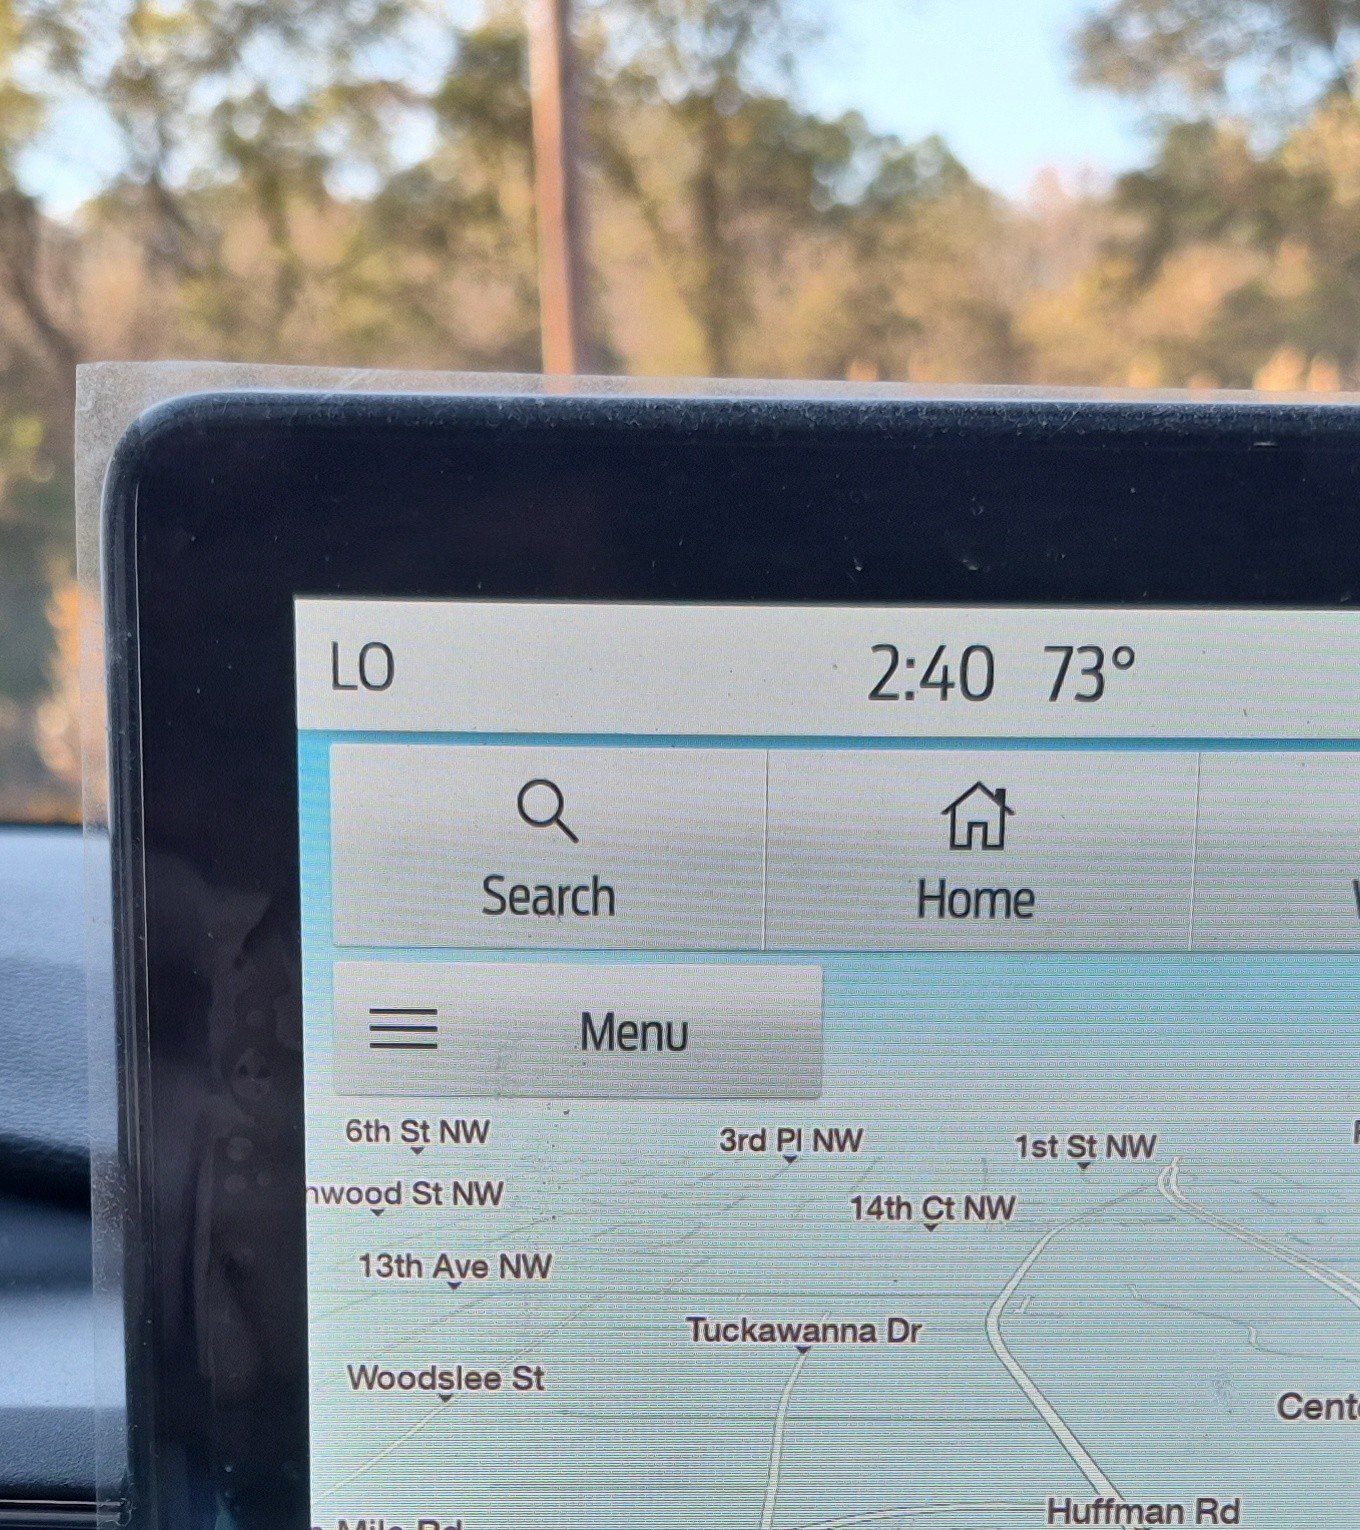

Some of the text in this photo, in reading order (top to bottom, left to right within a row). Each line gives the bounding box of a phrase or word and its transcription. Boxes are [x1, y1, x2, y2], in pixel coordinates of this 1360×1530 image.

[331, 640, 395, 692] LO
[867, 643, 1136, 704] 2:40 73°
[481, 874, 617, 919] Search
[916, 878, 1037, 921] Home
[580, 1011, 690, 1054] Menu
[345, 1118, 490, 1144] 6th St NW
[719, 1127, 864, 1153] 3rd Pl NW
[1015, 1133, 1158, 1159] 1st St NW
[411, 1180, 443, 1205] St
[452, 1180, 505, 1206] NW
[850, 1194, 1017, 1221] 14th Ct NW
[358, 1252, 553, 1280] 13th Ave NW
[685, 1316, 923, 1343] Tuckawanna Dr
[346, 1364, 545, 1391] Woodslee St
[1046, 1496, 1241, 1525] Huffman Rd
